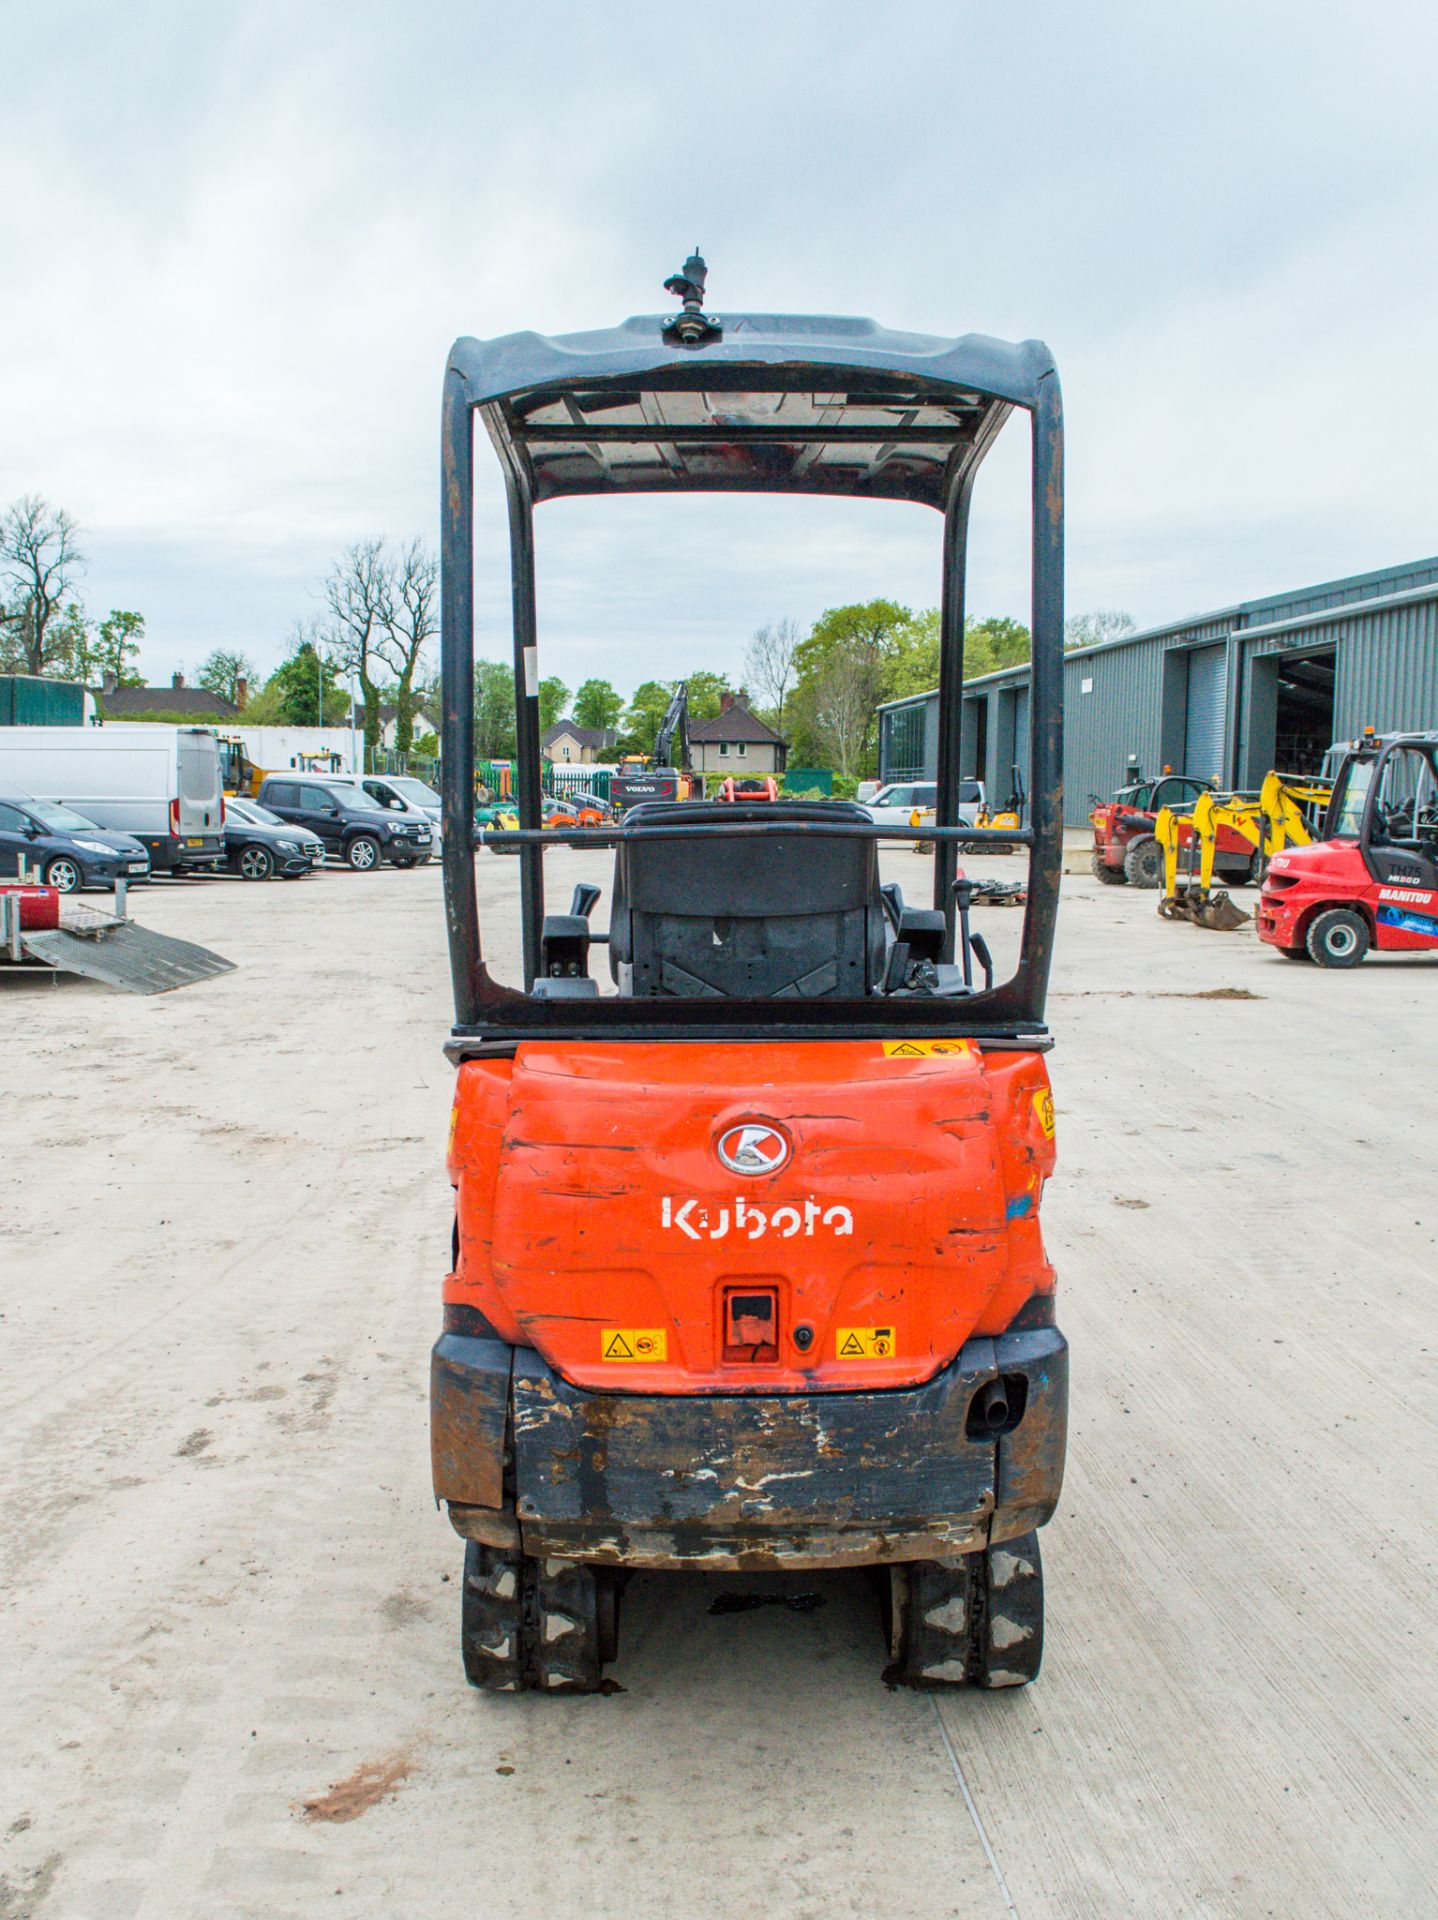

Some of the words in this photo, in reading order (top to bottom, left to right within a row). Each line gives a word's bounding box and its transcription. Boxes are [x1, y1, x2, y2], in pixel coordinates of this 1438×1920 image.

[625, 785, 656, 793] VOLVO
[1379, 888, 1432, 904] MANITOU
[661, 1195, 854, 1240] Kubota
